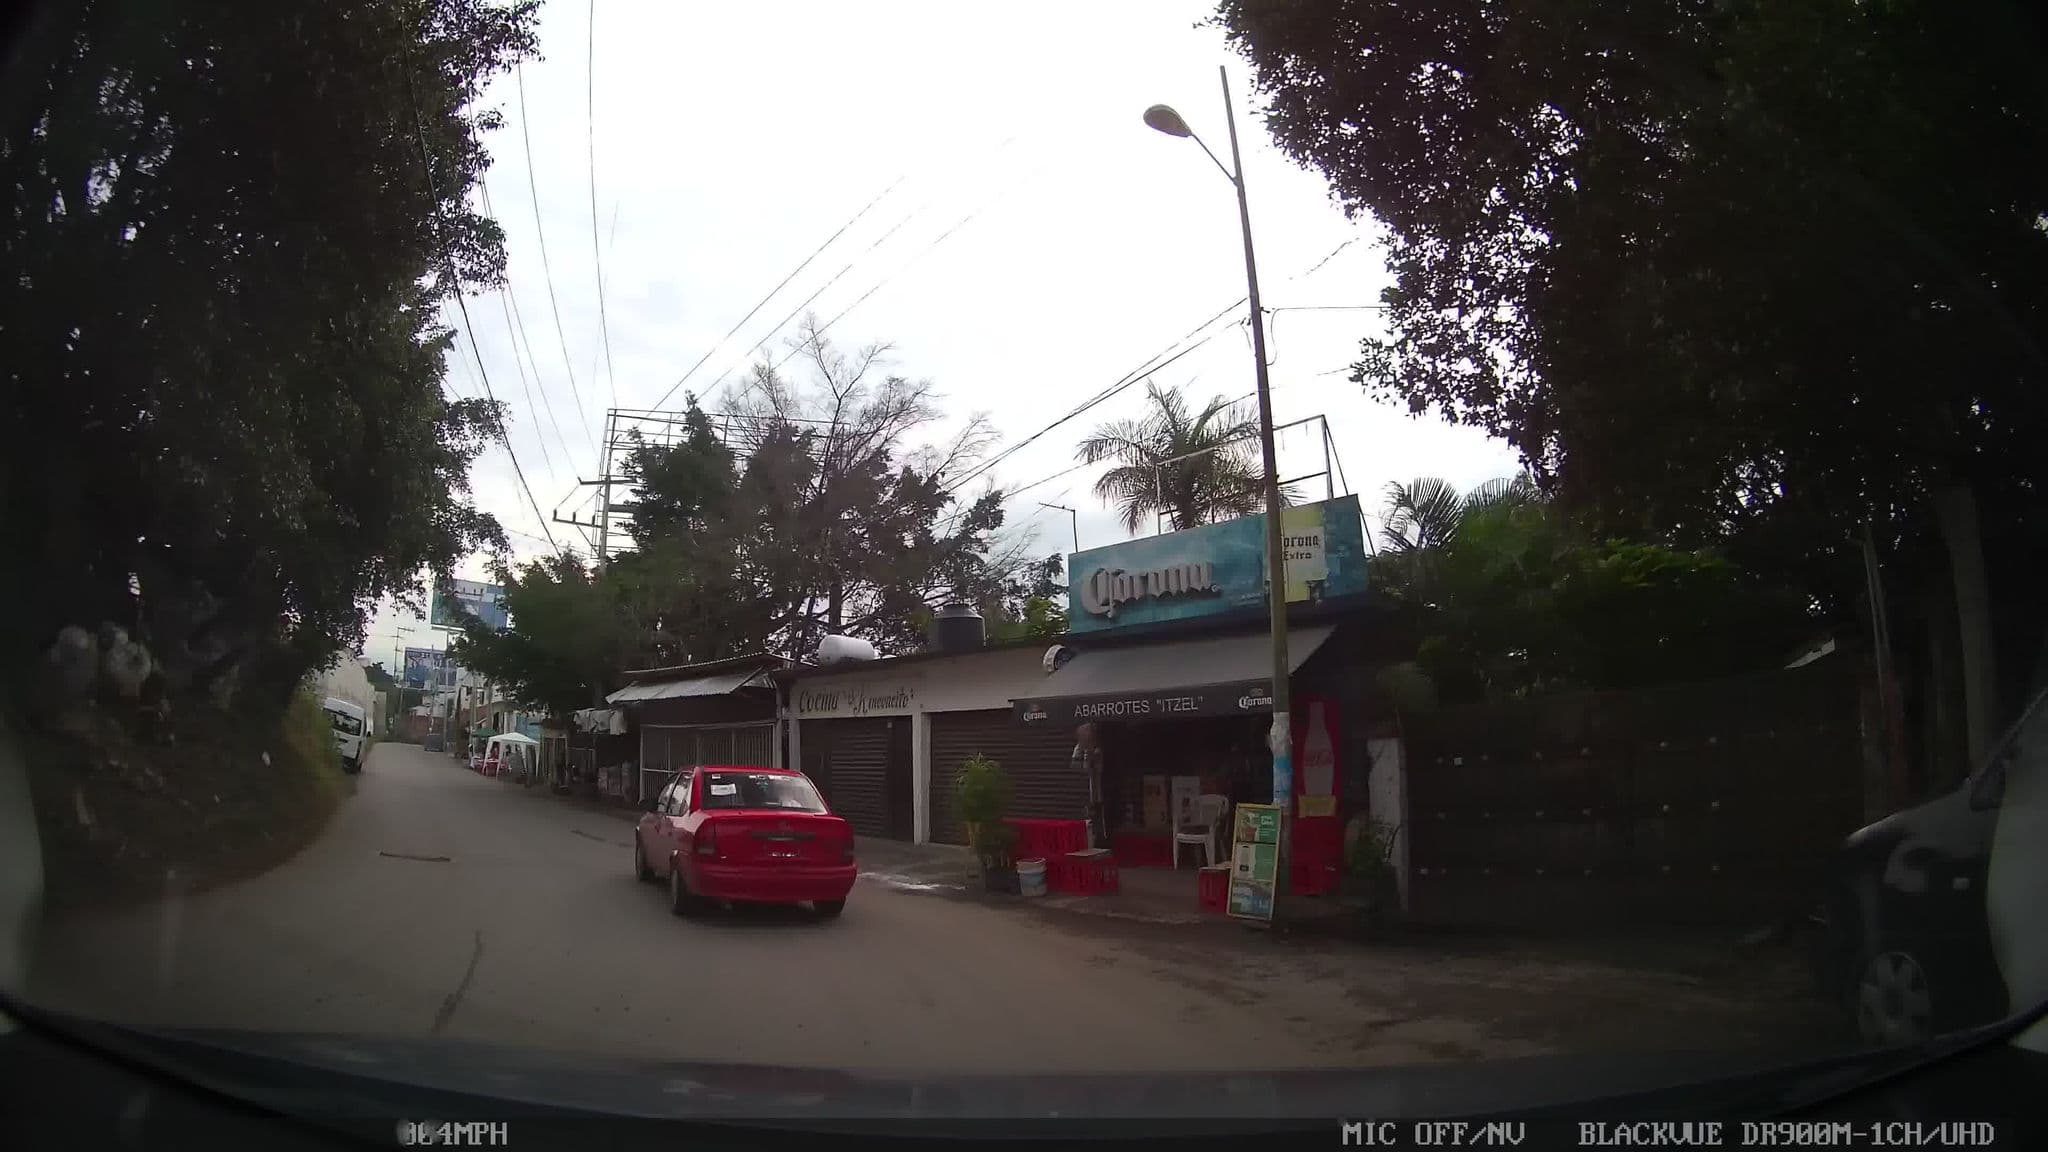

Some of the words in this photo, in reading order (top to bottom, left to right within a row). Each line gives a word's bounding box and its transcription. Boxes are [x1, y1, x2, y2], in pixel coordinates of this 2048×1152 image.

[1282, 535, 1319, 549] orona
[1073, 699, 1150, 718] ABARROTES
[1156, 695, 1204, 713] "ITZEL"
[1238, 695, 1273, 710] Corona
[1023, 711, 1048, 722] Corona
